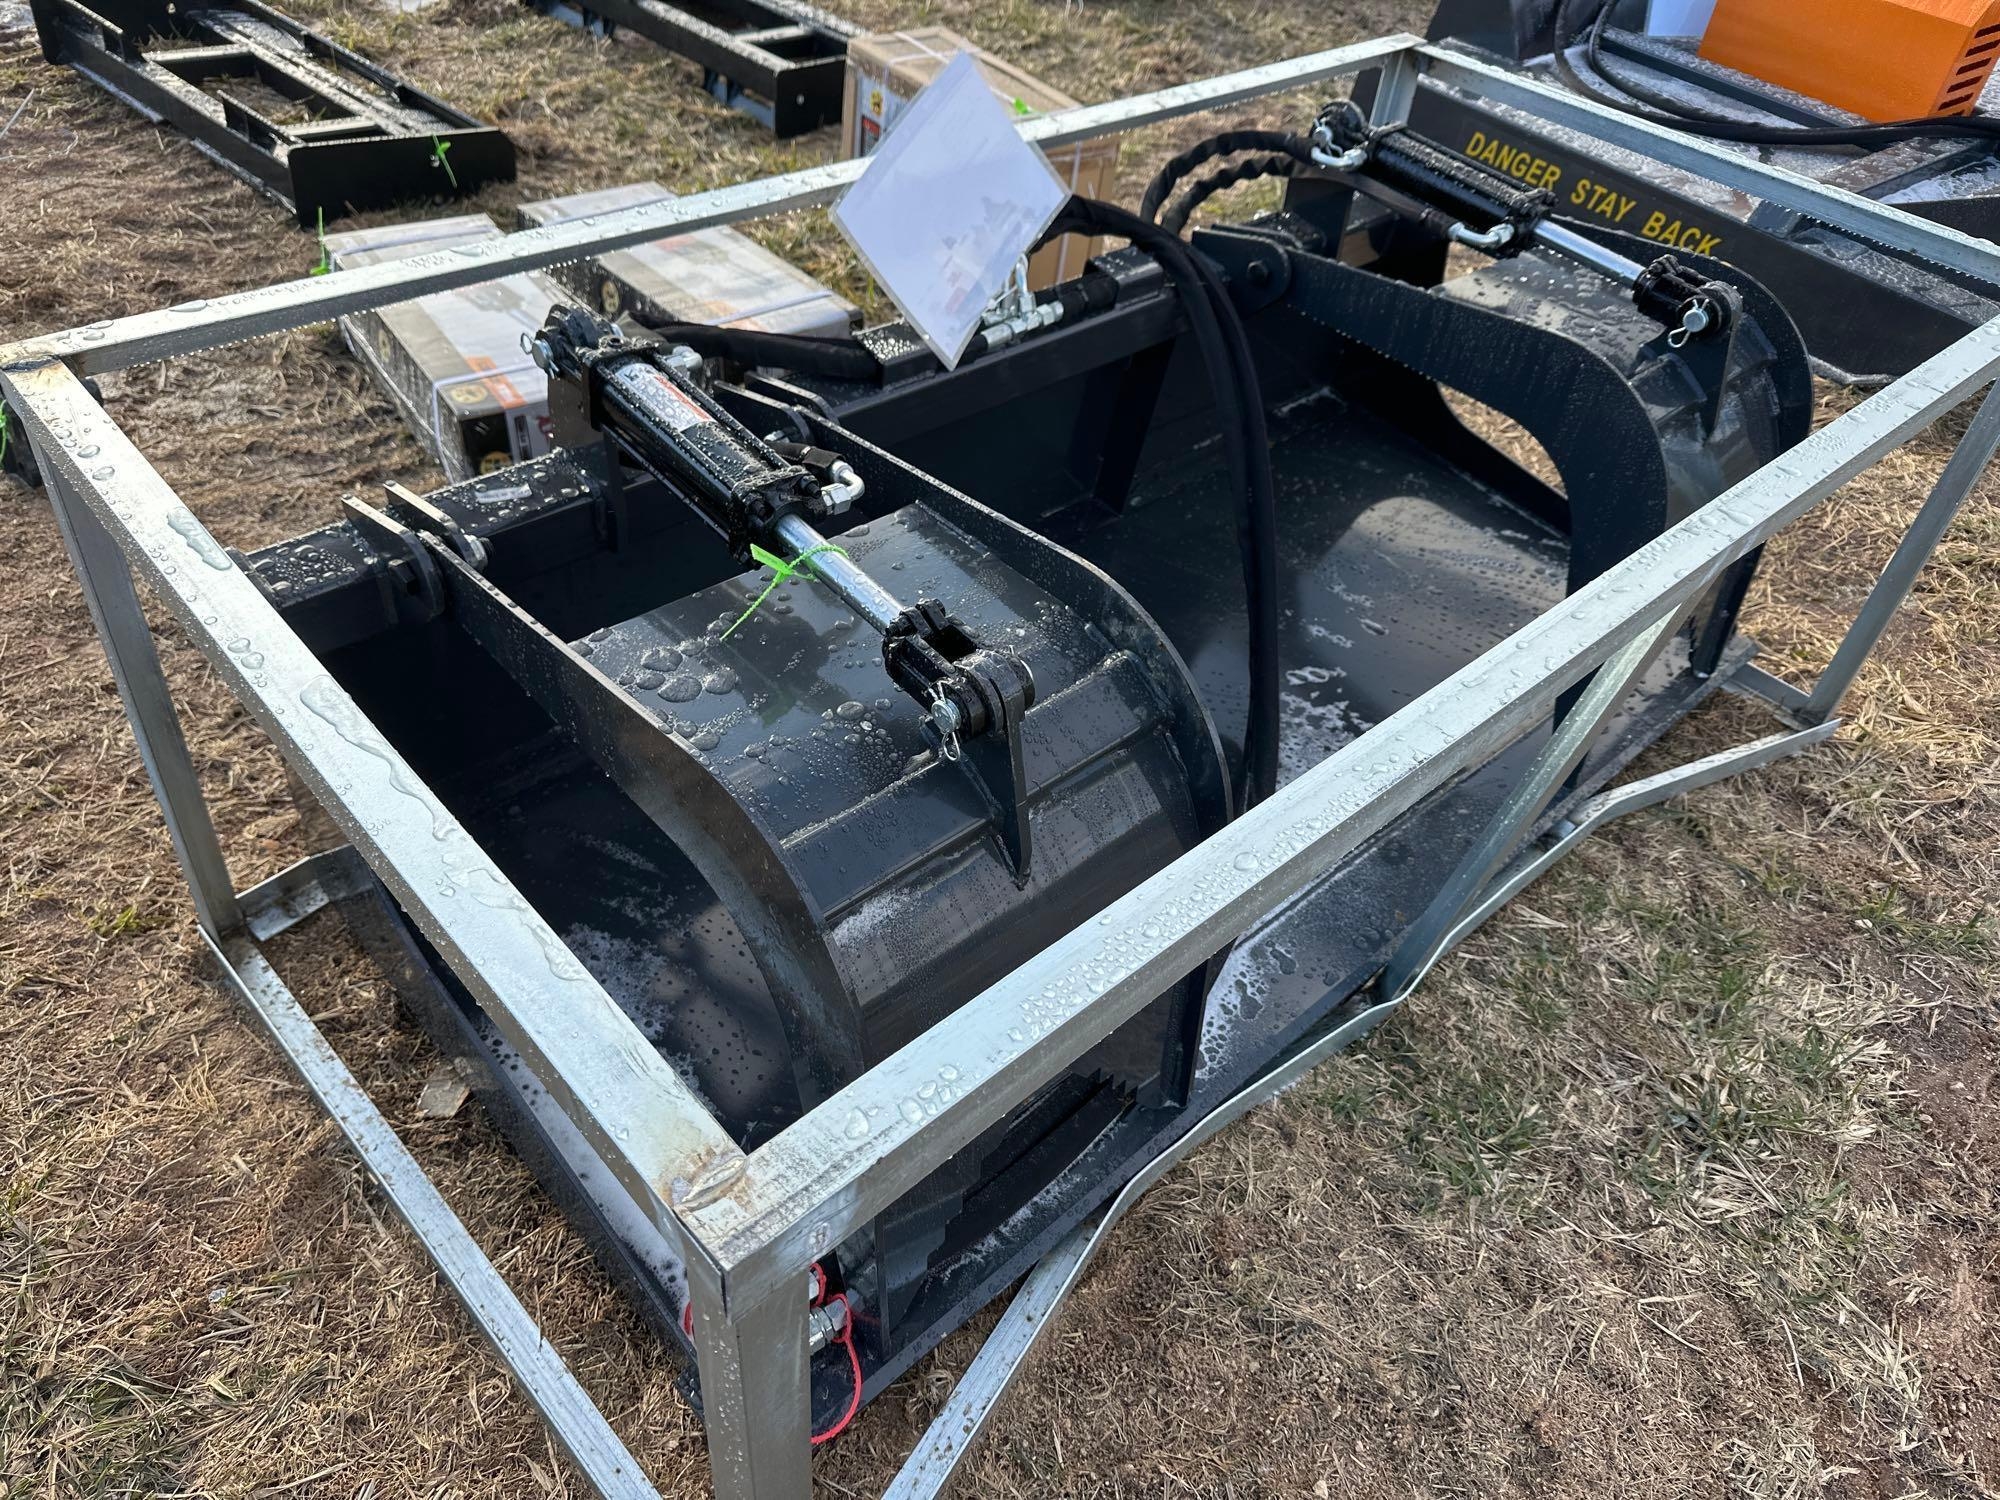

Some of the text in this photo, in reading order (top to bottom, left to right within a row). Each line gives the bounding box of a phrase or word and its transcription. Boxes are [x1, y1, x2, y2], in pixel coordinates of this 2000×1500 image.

[1466, 131, 1722, 256] DANGER STAY BACK
